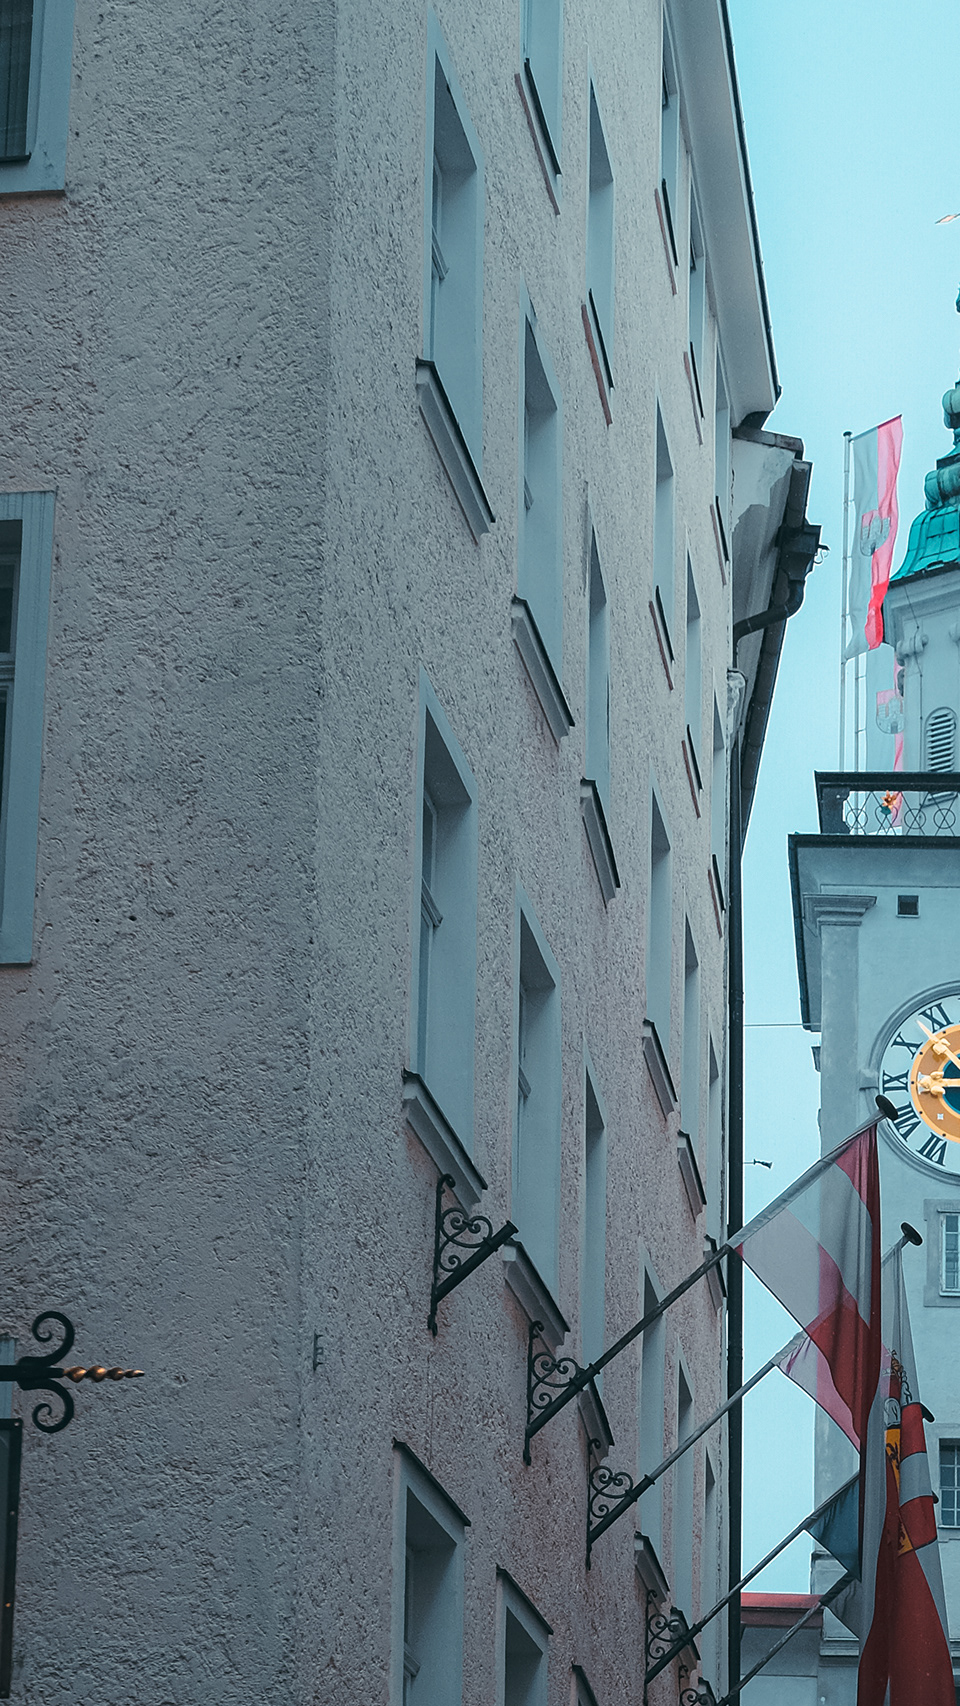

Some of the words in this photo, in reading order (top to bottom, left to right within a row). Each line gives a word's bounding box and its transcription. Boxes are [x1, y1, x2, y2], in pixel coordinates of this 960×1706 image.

[919, 1002, 954, 1034] XI
[891, 1031, 923, 1060] X
[916, 1132, 948, 1166] VII
